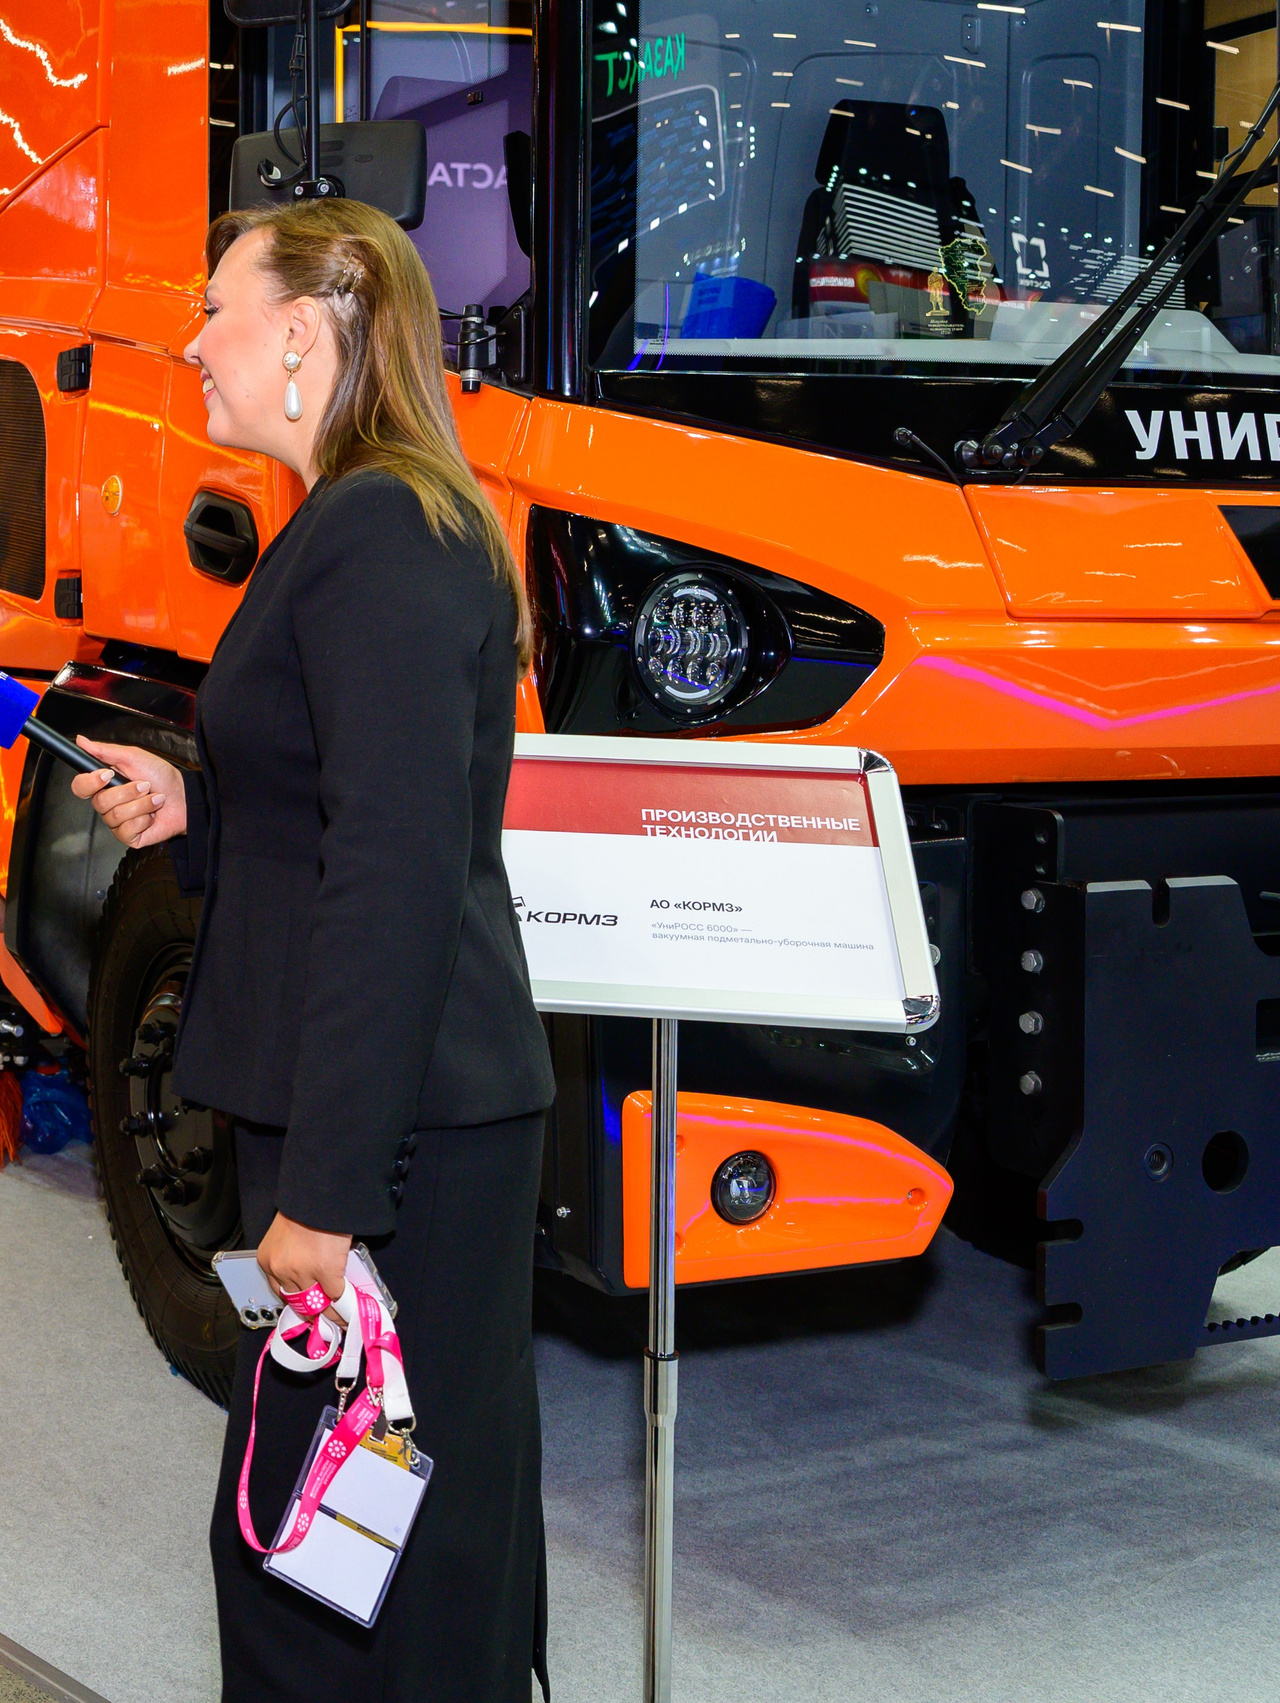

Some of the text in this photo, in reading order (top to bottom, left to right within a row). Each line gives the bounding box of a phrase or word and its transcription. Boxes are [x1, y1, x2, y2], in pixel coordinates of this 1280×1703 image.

[641, 808, 861, 831] ПРОИЗВОДСТВЕННЫЕ
[642, 824, 778, 843] ТЕХНОЛОГИИ
[649, 899, 743, 913] АО «КОРМЗ»
[526, 911, 619, 927] КОРМЗ
[651, 921, 704, 932] «УниРОСС
[706, 924, 739, 933] 6000»
[652, 932, 875, 951] вакуумная подметально-уборочная машина
